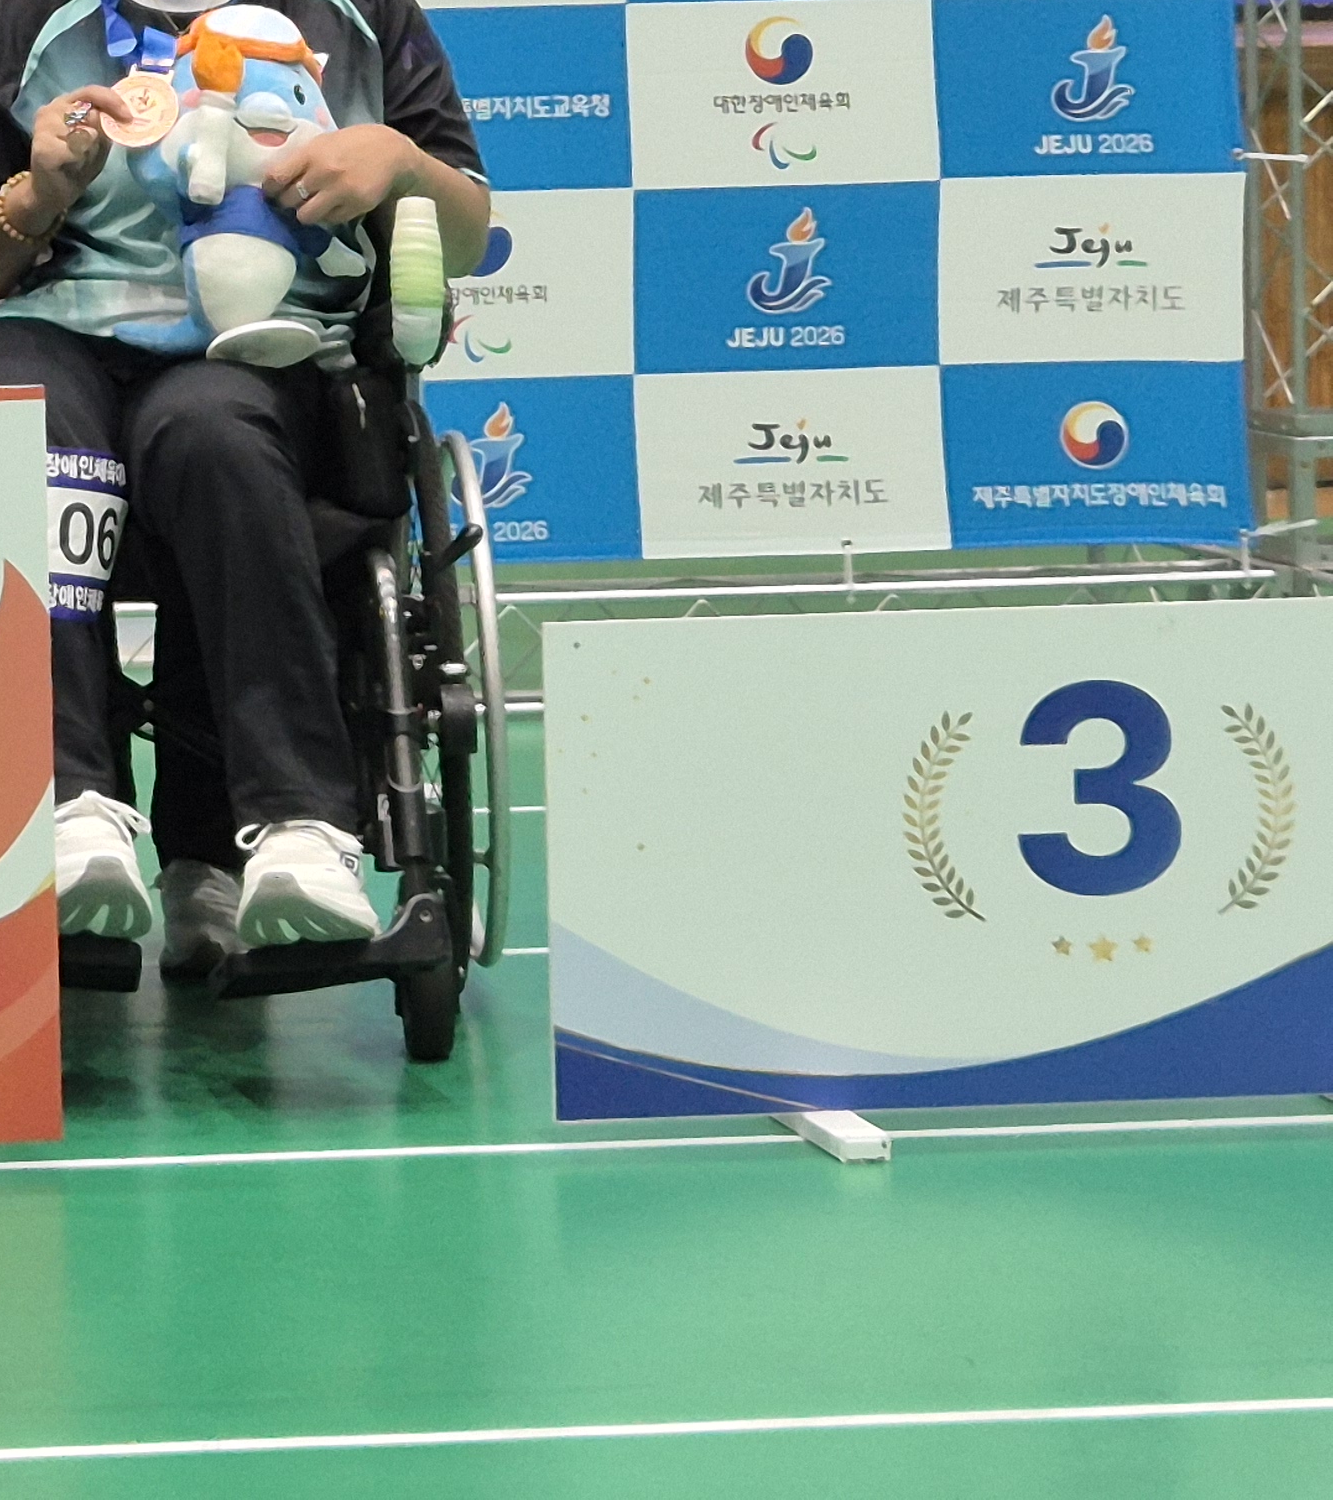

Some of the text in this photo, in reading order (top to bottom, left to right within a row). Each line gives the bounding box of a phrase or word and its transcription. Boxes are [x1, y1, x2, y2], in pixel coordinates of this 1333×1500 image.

[713, 91, 851, 114] 대한장애인체육회
[1033, 133, 1154, 155] JEJU 2026
[1049, 220, 1137, 272] Jeju
[997, 284, 1186, 315] 제주특별자치도
[725, 324, 845, 348] JEJU 2026
[747, 416, 839, 466] Jeju
[698, 478, 889, 510] 제주특별자치도
[972, 481, 1227, 509] 제주특별자치도장애인체육회
[492, 520, 549, 543] 2026
[1017, 679, 1182, 897] 3
